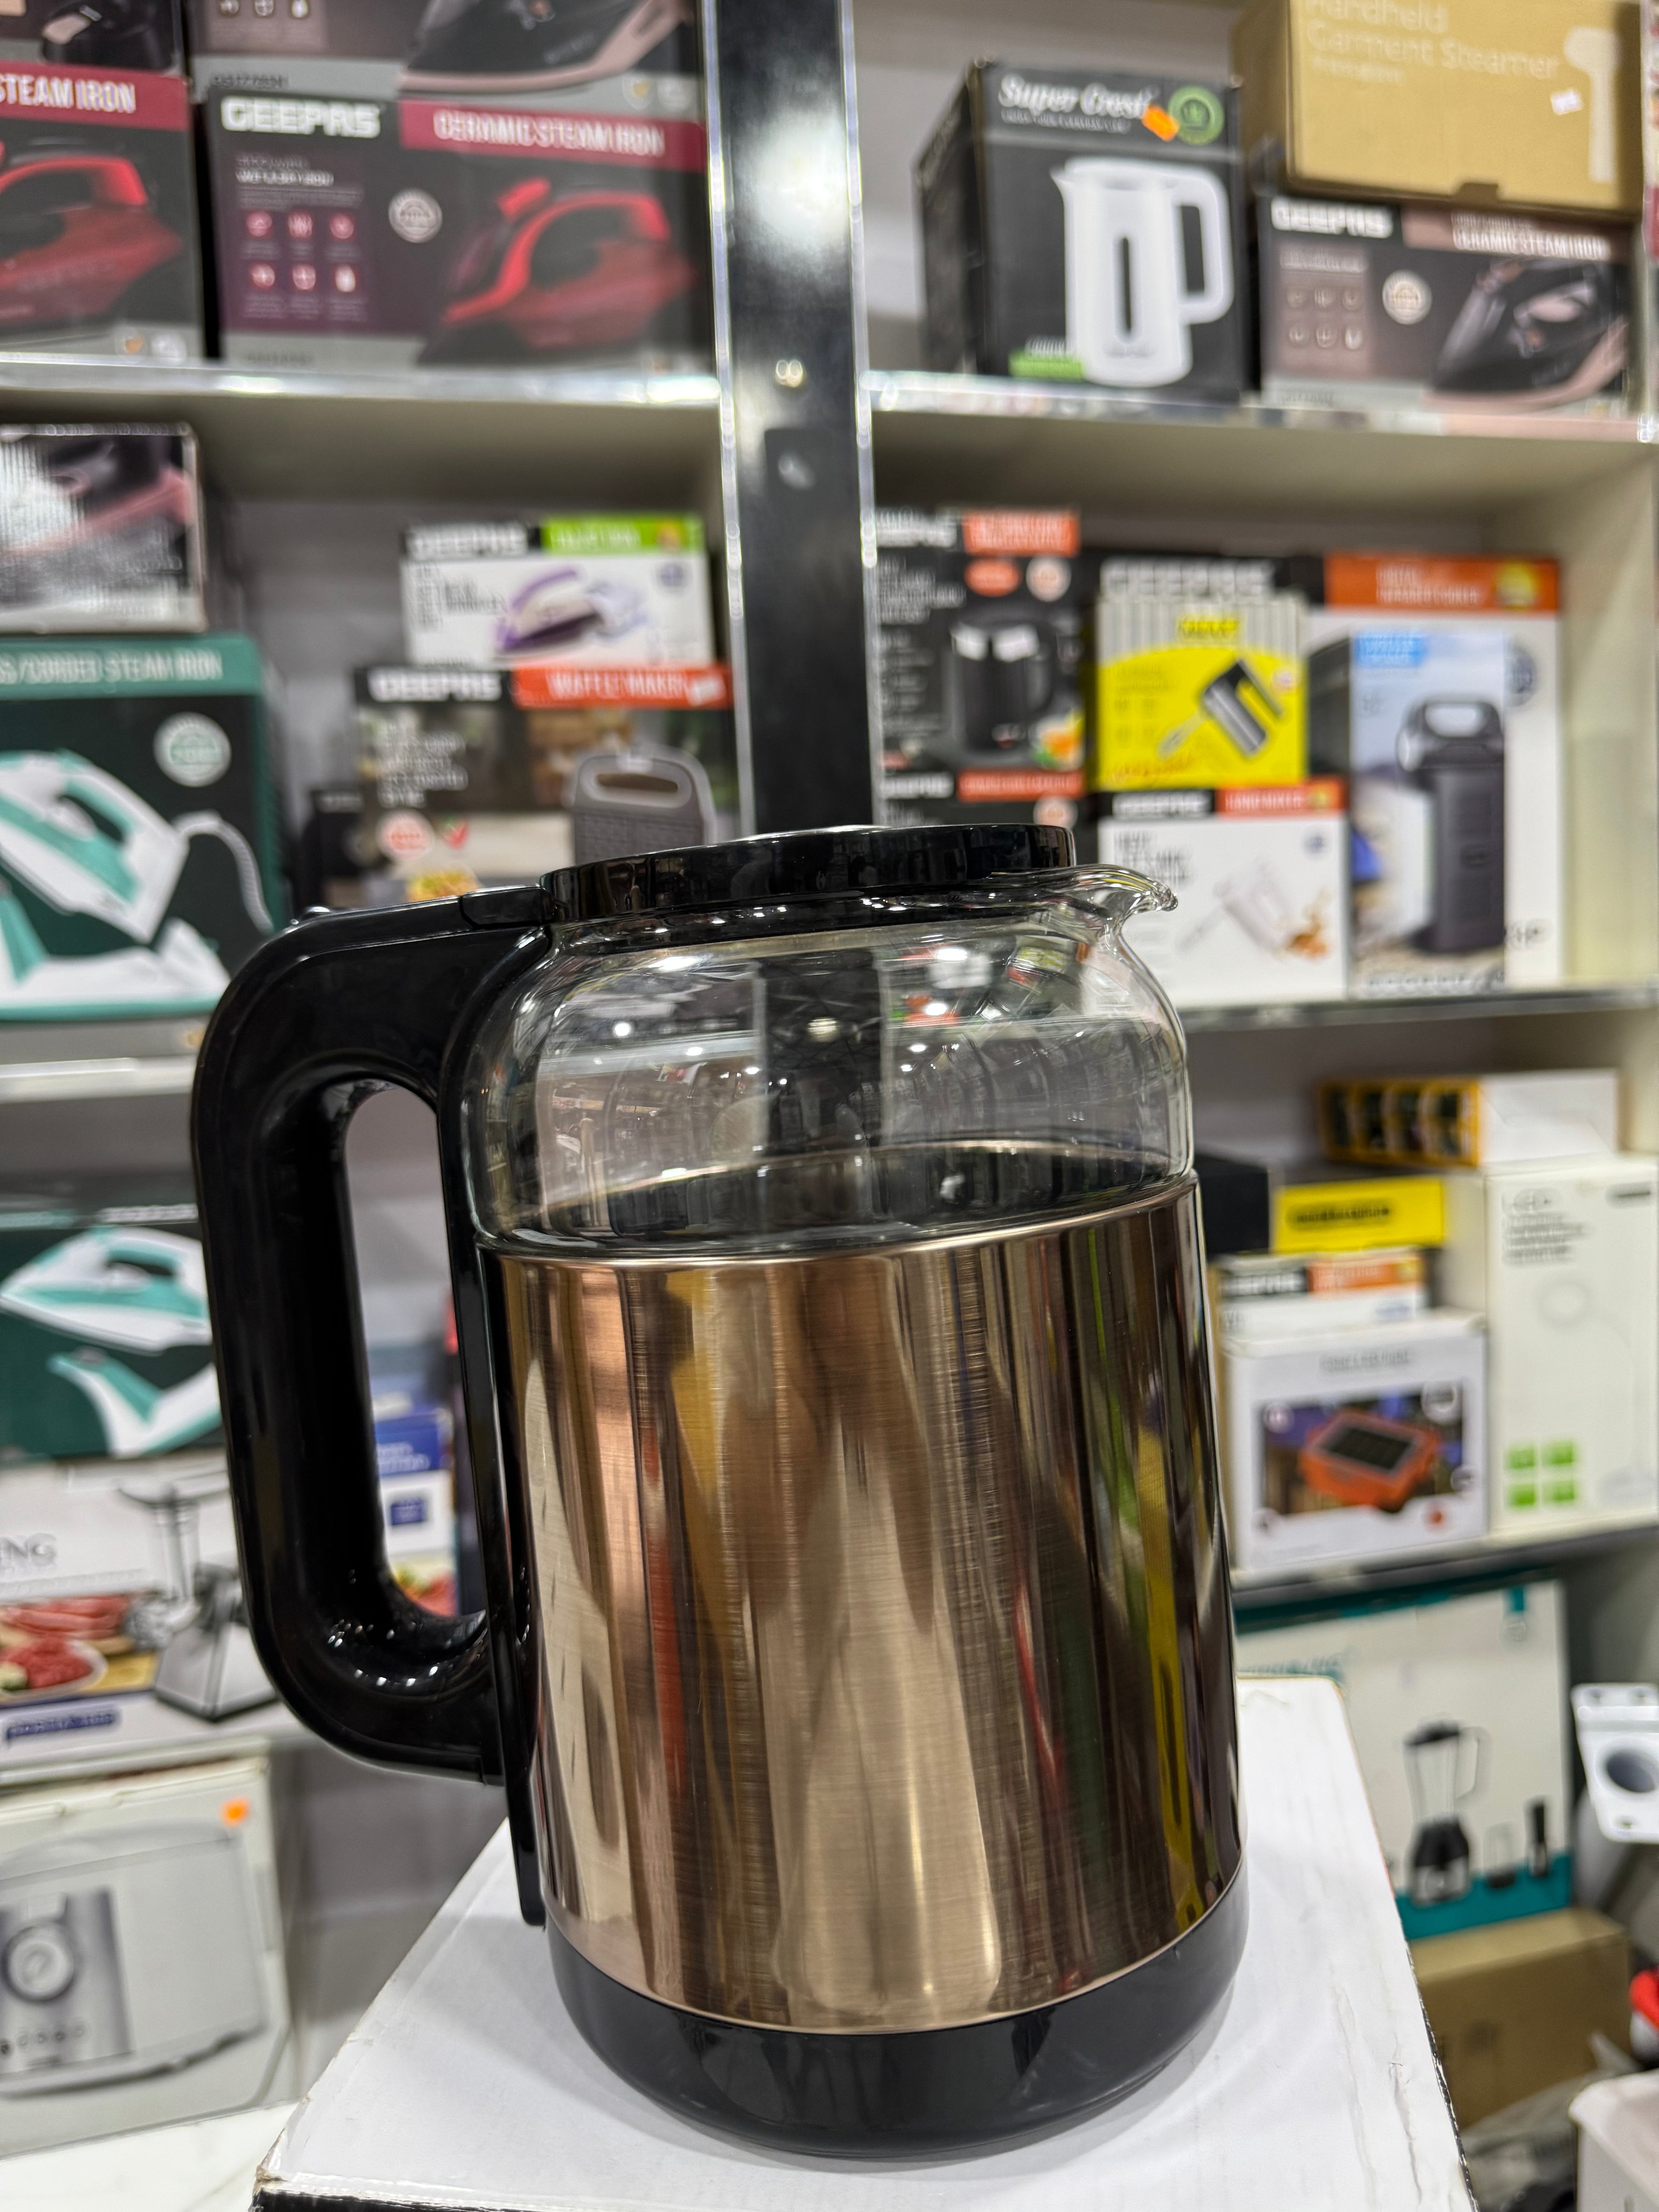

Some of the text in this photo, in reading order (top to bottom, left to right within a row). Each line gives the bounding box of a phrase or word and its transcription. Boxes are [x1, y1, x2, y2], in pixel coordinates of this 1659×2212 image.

[1440, 38, 1560, 79] Steamer
[74, 78, 136, 114] IRON
[998, 73, 1079, 116] Super
